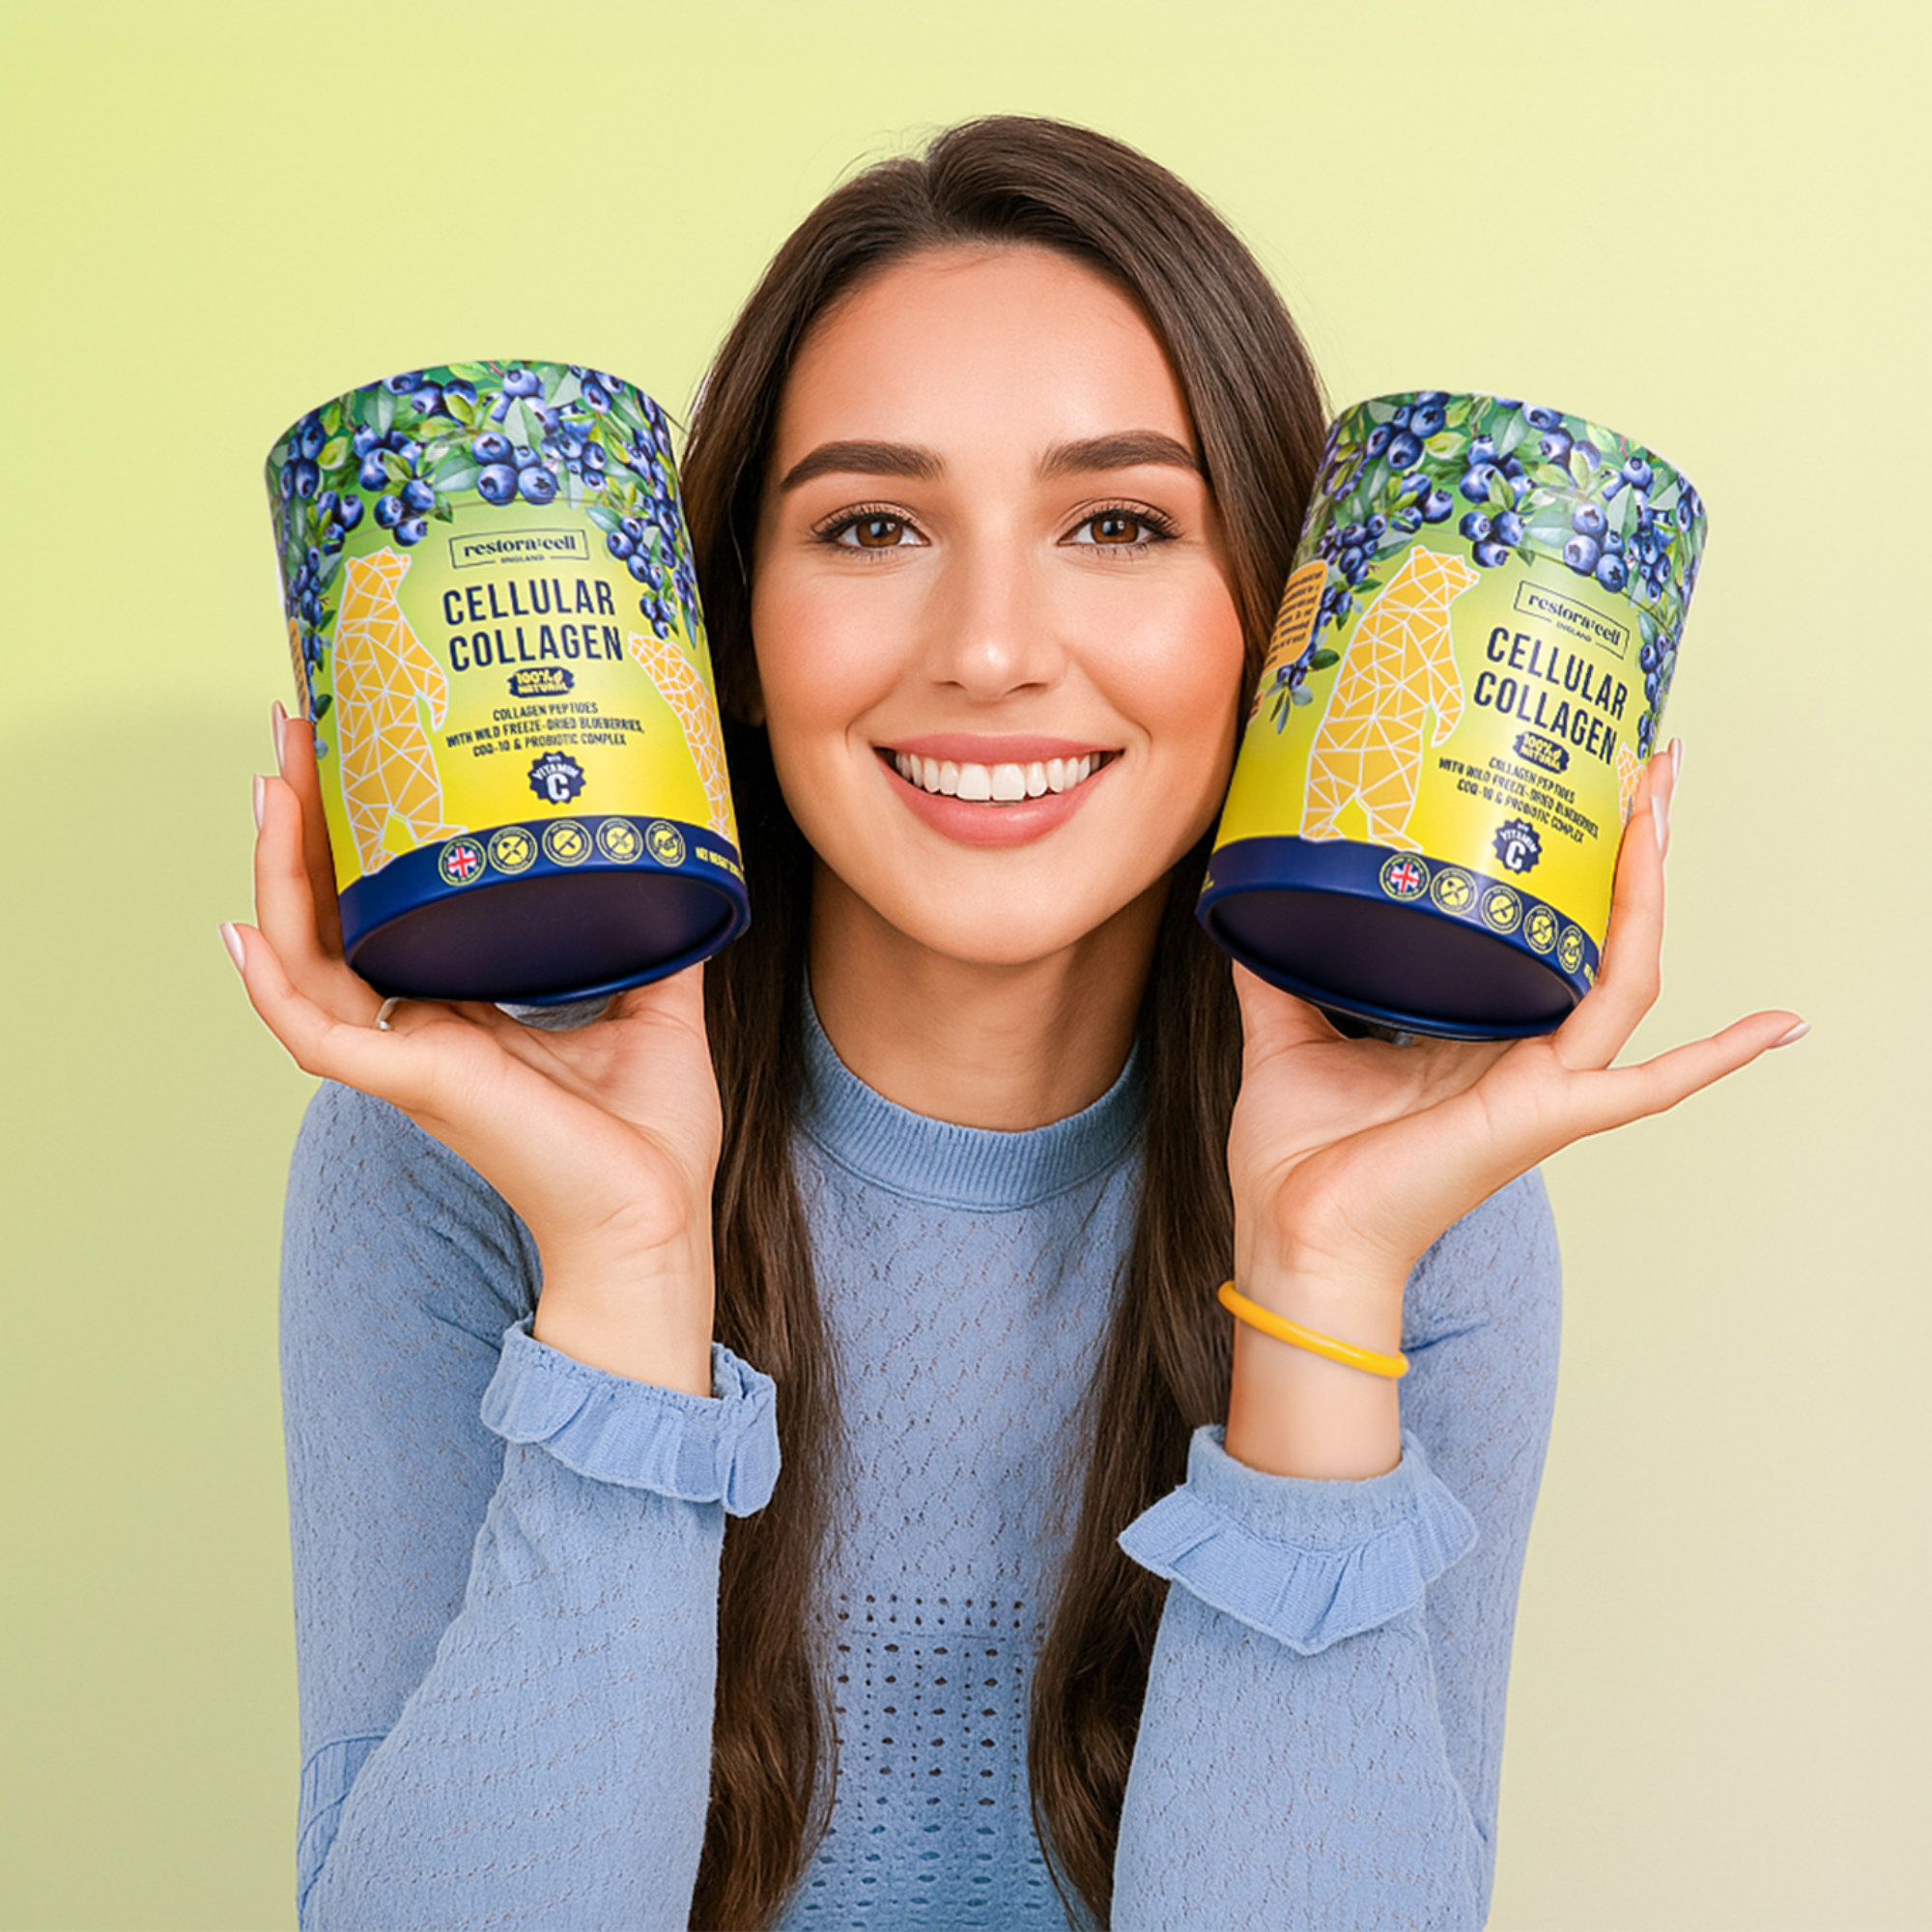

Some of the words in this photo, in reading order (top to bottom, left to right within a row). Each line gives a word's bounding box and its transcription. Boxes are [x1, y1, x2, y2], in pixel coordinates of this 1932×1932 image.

[463, 535, 577, 557] restora:cell
[500, 554, 545, 563] ENGLAND
[442, 578, 615, 626] CELLULAR
[1555, 620, 1593, 642] ENGLAND
[449, 624, 623, 671] COLLAGEN
[515, 668, 552, 685] 100%
[1486, 626, 1628, 722] CELLULAR
[493, 704, 547, 722] COLLAGEN
[549, 701, 599, 716] PEPTIDES
[1473, 670, 1618, 766] COLLAGEN
[445, 730, 472, 749] WITH
[475, 725, 500, 740] WILD
[502, 717, 578, 737] FREEZE-DRIED
[472, 739, 511, 757] COQ-10
[513, 738, 523, 751] &
[525, 733, 579, 750] PROBIOTIC
[581, 732, 627, 746] COMPLEX
[531, 763, 581, 781] VITAMIN
[1438, 756, 1464, 775] WITH
[1465, 763, 1491, 782] WILD
[1488, 756, 1536, 785] COLLAGEN
[1536, 776, 1576, 805] PEPTIDES
[546, 773, 571, 802] C
[1494, 791, 1503, 805] &
[1504, 795, 1550, 824] PROBIOTIC
[1550, 815, 1585, 844] COMPLEX
[1498, 829, 1539, 854] VITAMIN
[1505, 839, 1526, 870] C
